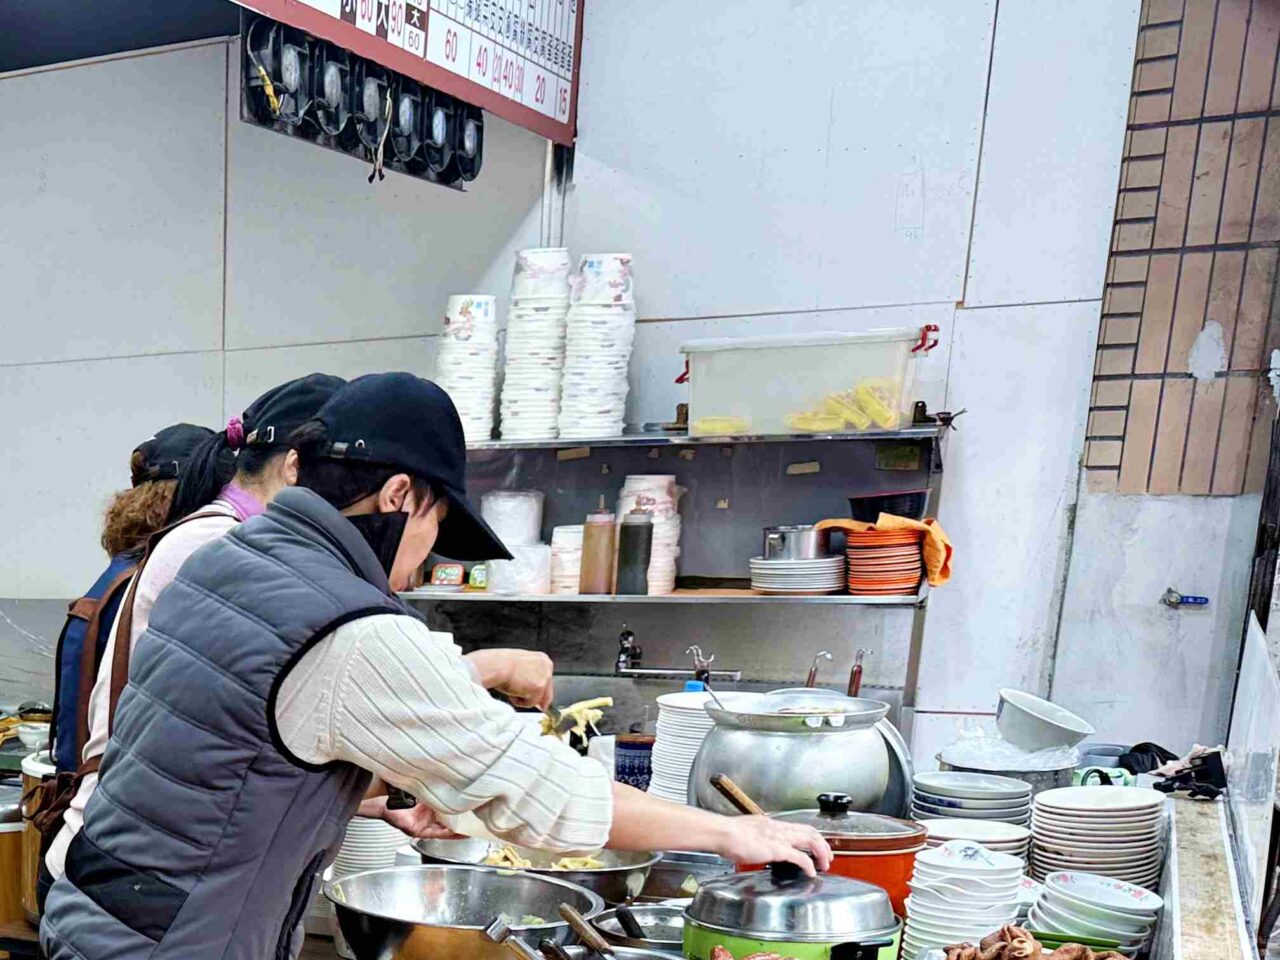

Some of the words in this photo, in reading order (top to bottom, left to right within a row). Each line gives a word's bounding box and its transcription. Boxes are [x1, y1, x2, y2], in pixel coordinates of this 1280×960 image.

[391, 1, 403, 37] 90
[410, 8, 420, 28] 大
[408, 30, 420, 51] 60
[445, 28, 458, 63] 60
[476, 45, 488, 77] 40
[503, 58, 514, 90] 40
[534, 74, 546, 105] 20
[559, 86, 568, 115] 15
